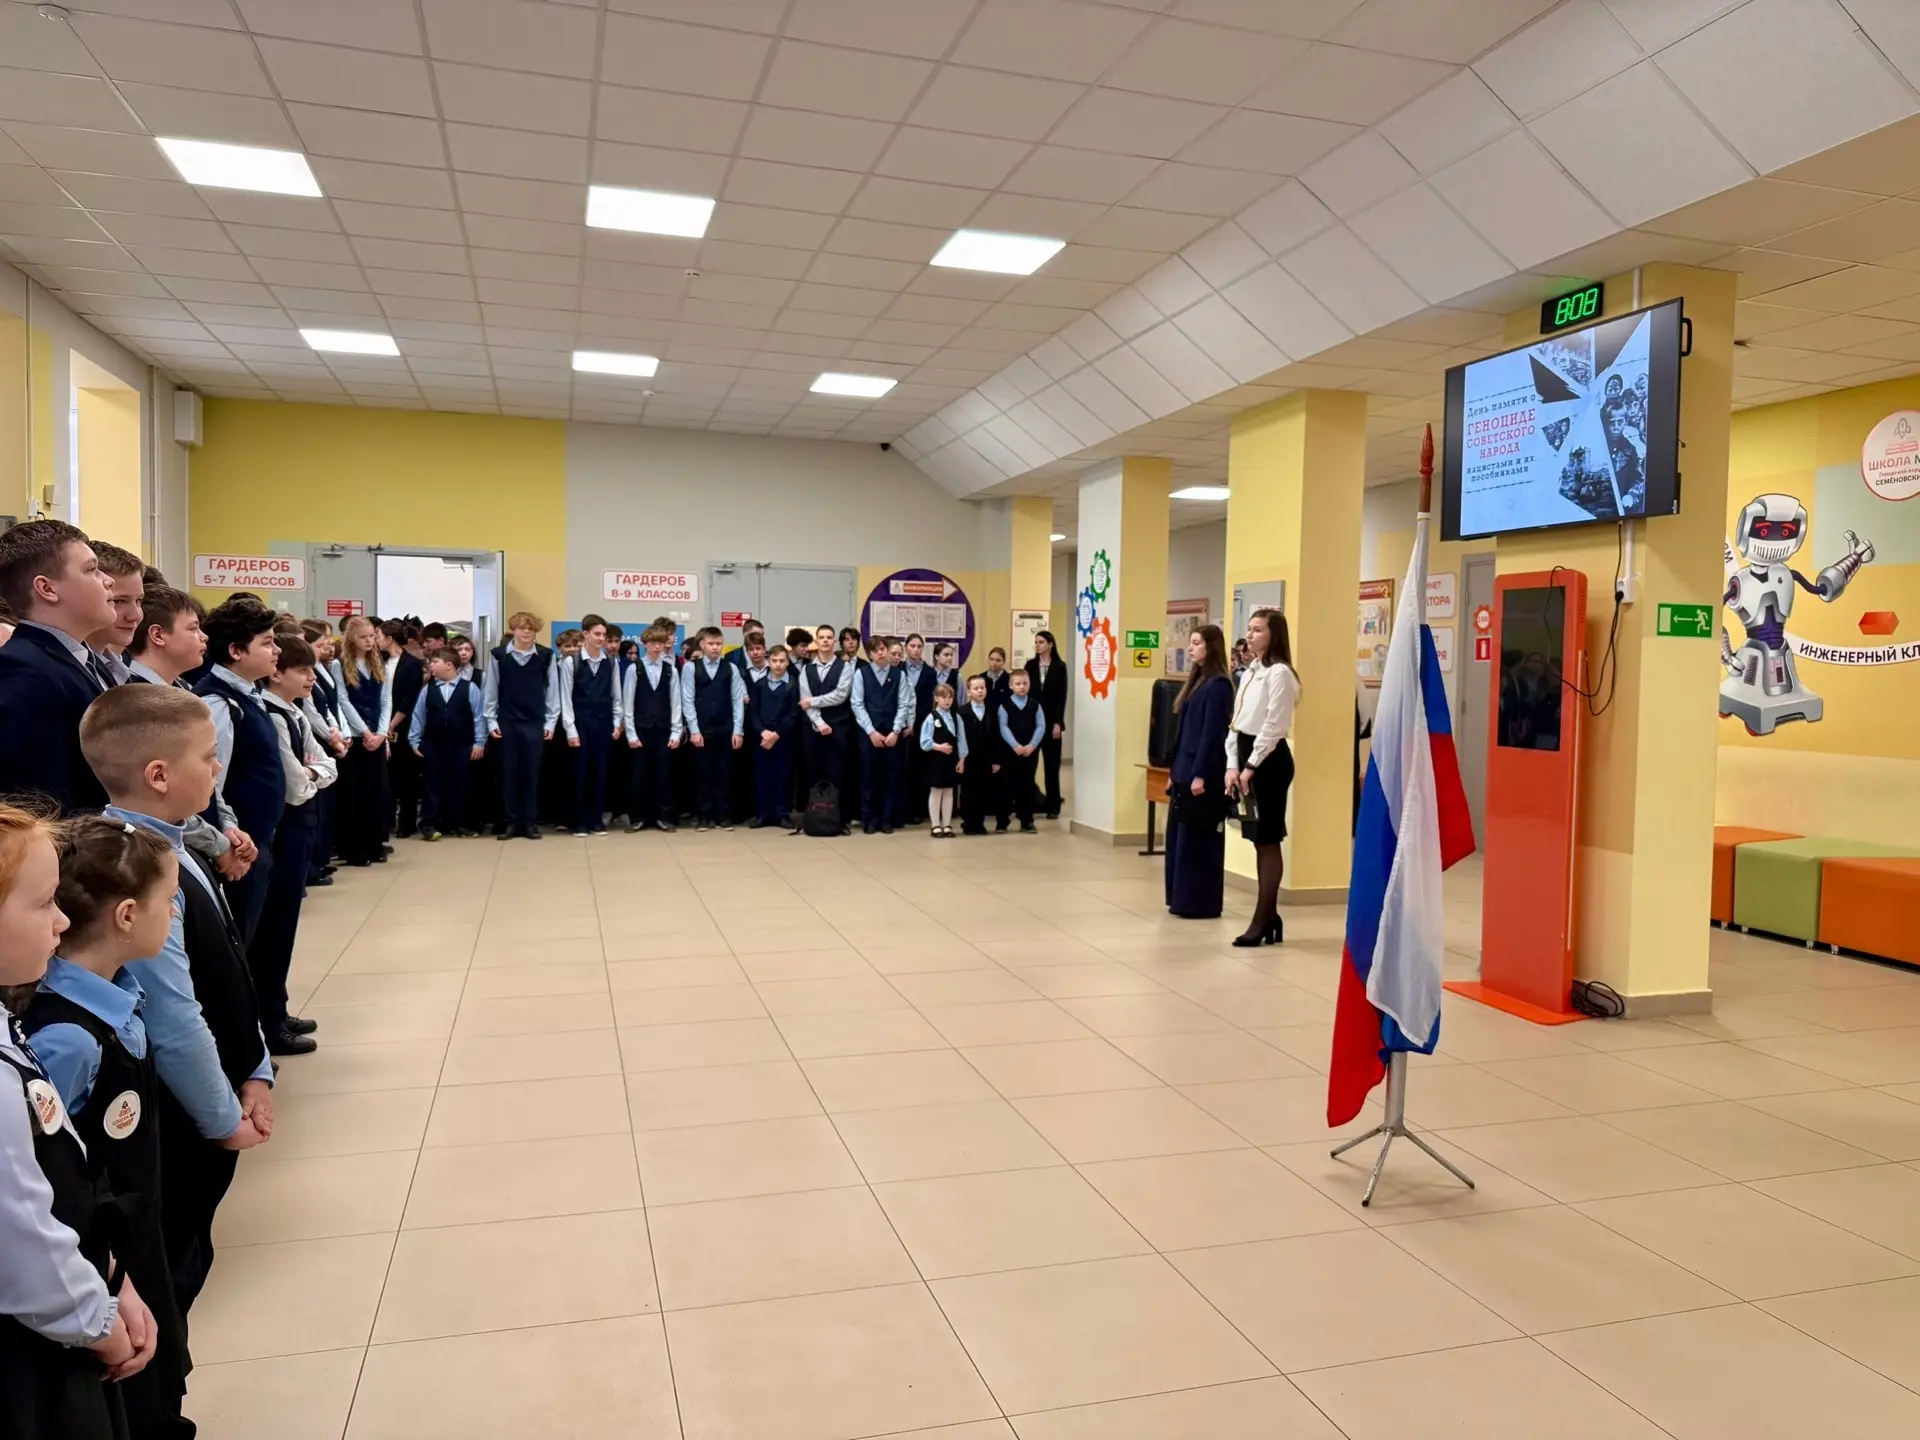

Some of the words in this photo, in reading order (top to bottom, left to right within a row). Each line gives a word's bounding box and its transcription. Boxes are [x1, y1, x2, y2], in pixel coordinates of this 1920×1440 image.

[1468, 405, 1489, 418] День
[1492, 395, 1528, 411] памяти
[1468, 408, 1536, 435] ГЕНОЦИДЕ
[1467, 425, 1536, 448] СОВЕТСКОГО
[1480, 442, 1520, 459] НАРОДА
[1466, 459, 1513, 474] нацистами
[1868, 456, 1911, 471] ШКОЛА
[1471, 466, 1529, 482] пособниками
[208, 558, 290, 573] ГАРДЕРОБ
[204, 574, 226, 585] 5-7
[233, 575, 296, 587] КЛАССОВ
[616, 574, 686, 587] ГАРДЕРОБ
[611, 589, 631, 598] 8-9
[637, 589, 691, 600] КЛАССОВ
[1799, 643, 1897, 663] ИНЖЕНЕРНЫЙ
